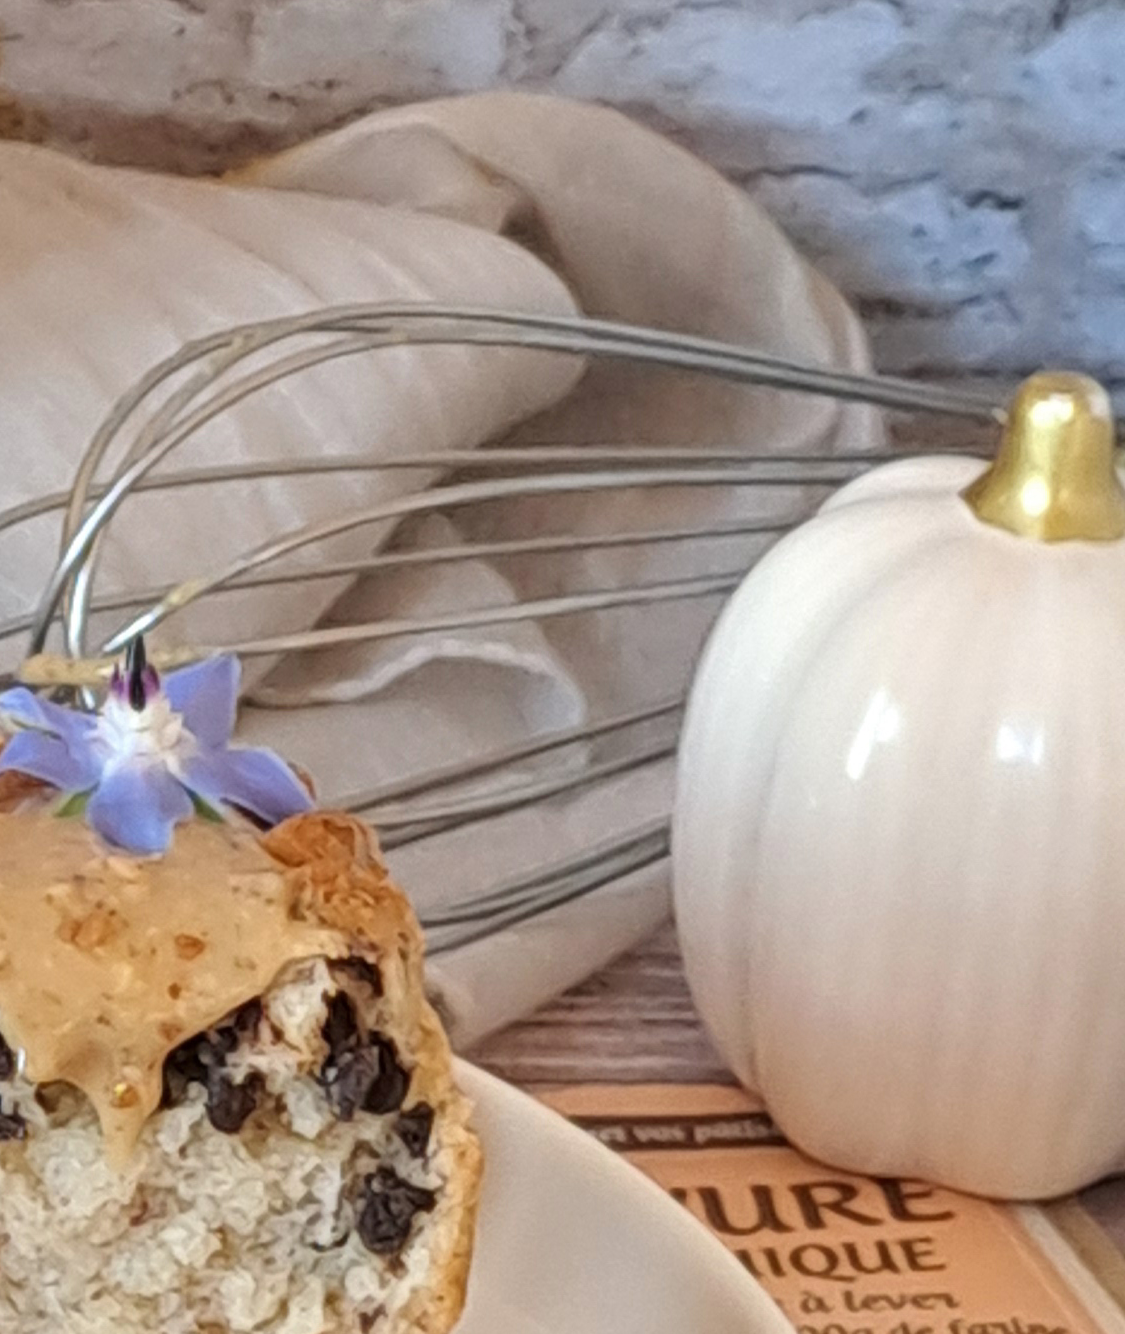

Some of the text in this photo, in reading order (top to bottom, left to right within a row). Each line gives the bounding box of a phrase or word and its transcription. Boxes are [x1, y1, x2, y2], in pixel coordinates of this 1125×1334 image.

[670, 1178, 955, 1236] URE
[735, 1236, 947, 1283] IQUE
[800, 1289, 960, 1314] à lever
